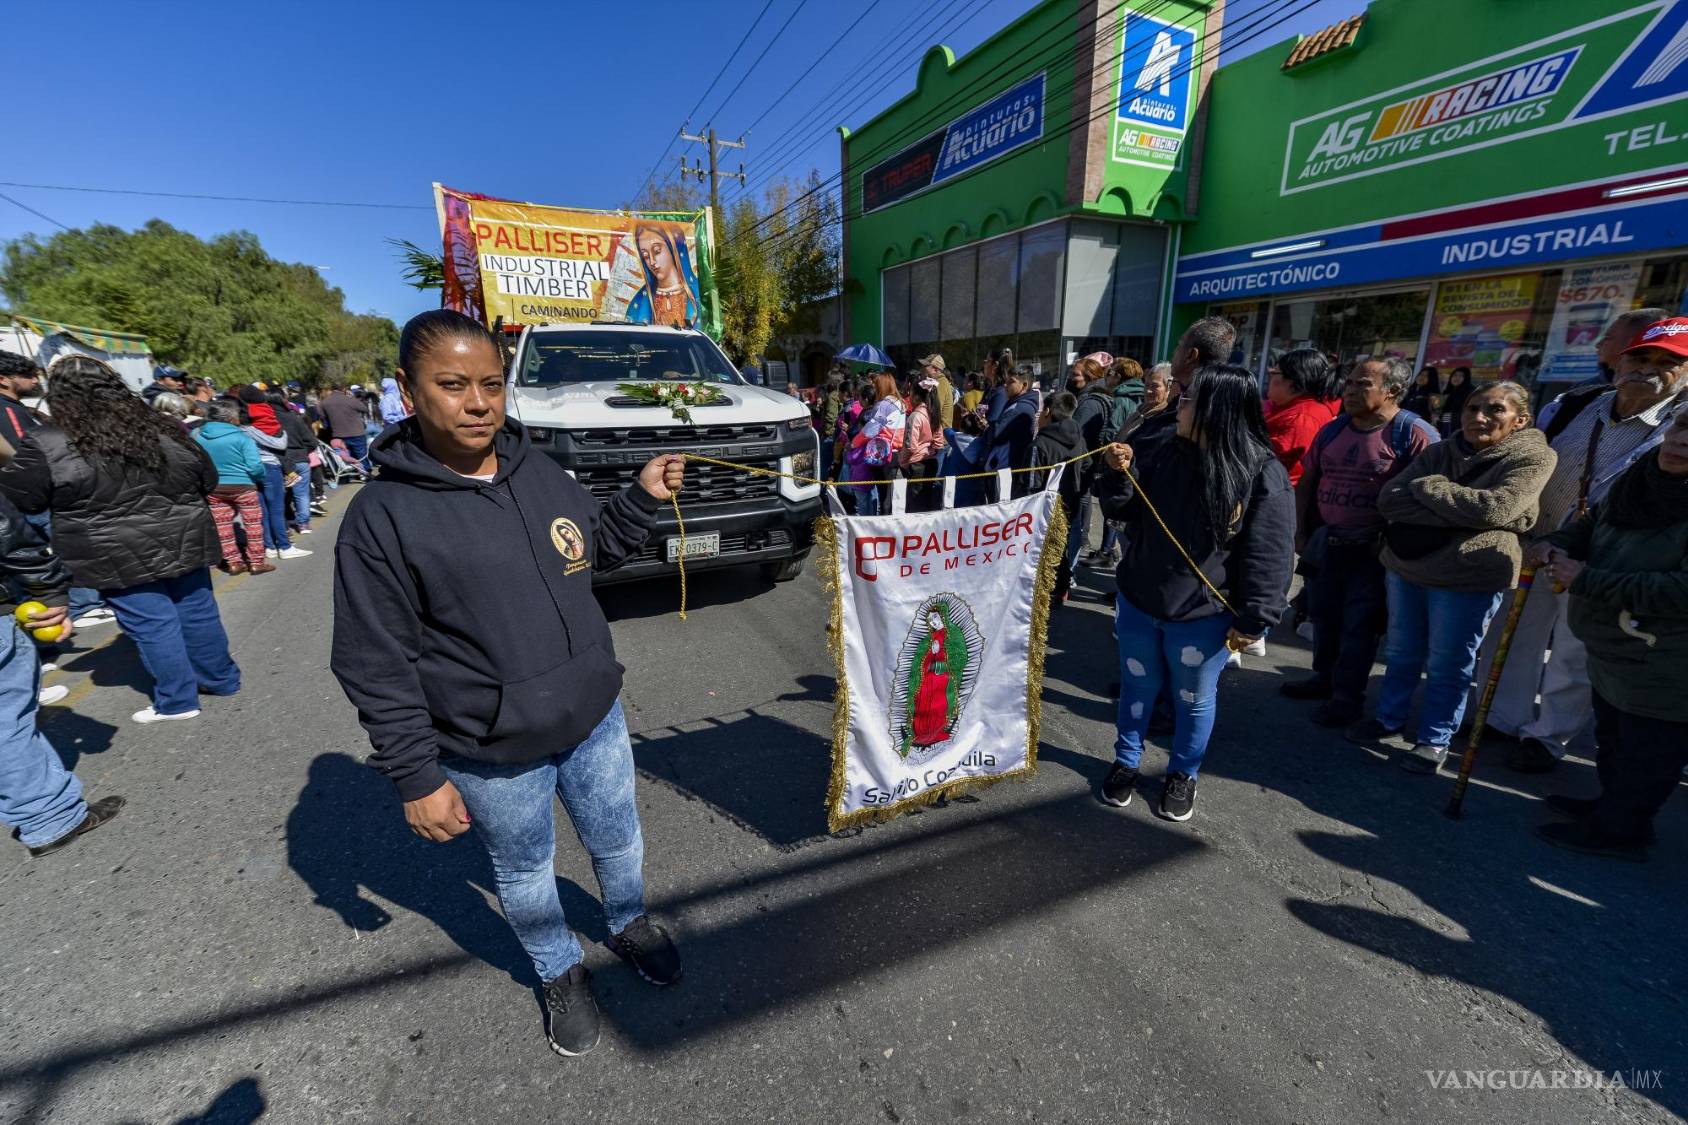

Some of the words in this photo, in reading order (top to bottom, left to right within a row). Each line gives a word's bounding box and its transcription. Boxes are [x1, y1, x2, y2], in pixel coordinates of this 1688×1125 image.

[1128, 95, 1176, 121] Acuario
[1306, 111, 1373, 162] AG
[1421, 57, 1565, 126] RACING
[1119, 128, 1138, 147] AG
[1150, 136, 1179, 152] RACING
[1299, 134, 1426, 180] AUTOMOTIVE
[1429, 98, 1552, 146] COATINGS
[475, 223, 604, 257] PALLISER
[1441, 220, 1634, 266] INDUSTRIAL
[484, 255, 609, 281] INDUSTRIAL
[1190, 262, 1340, 296] ARQUITECTÓNICO
[499, 274, 590, 298] TIMBER
[521, 304, 598, 319] CAMINANDO
[901, 512, 1033, 558] PALLISER
[900, 562, 930, 578] DE
